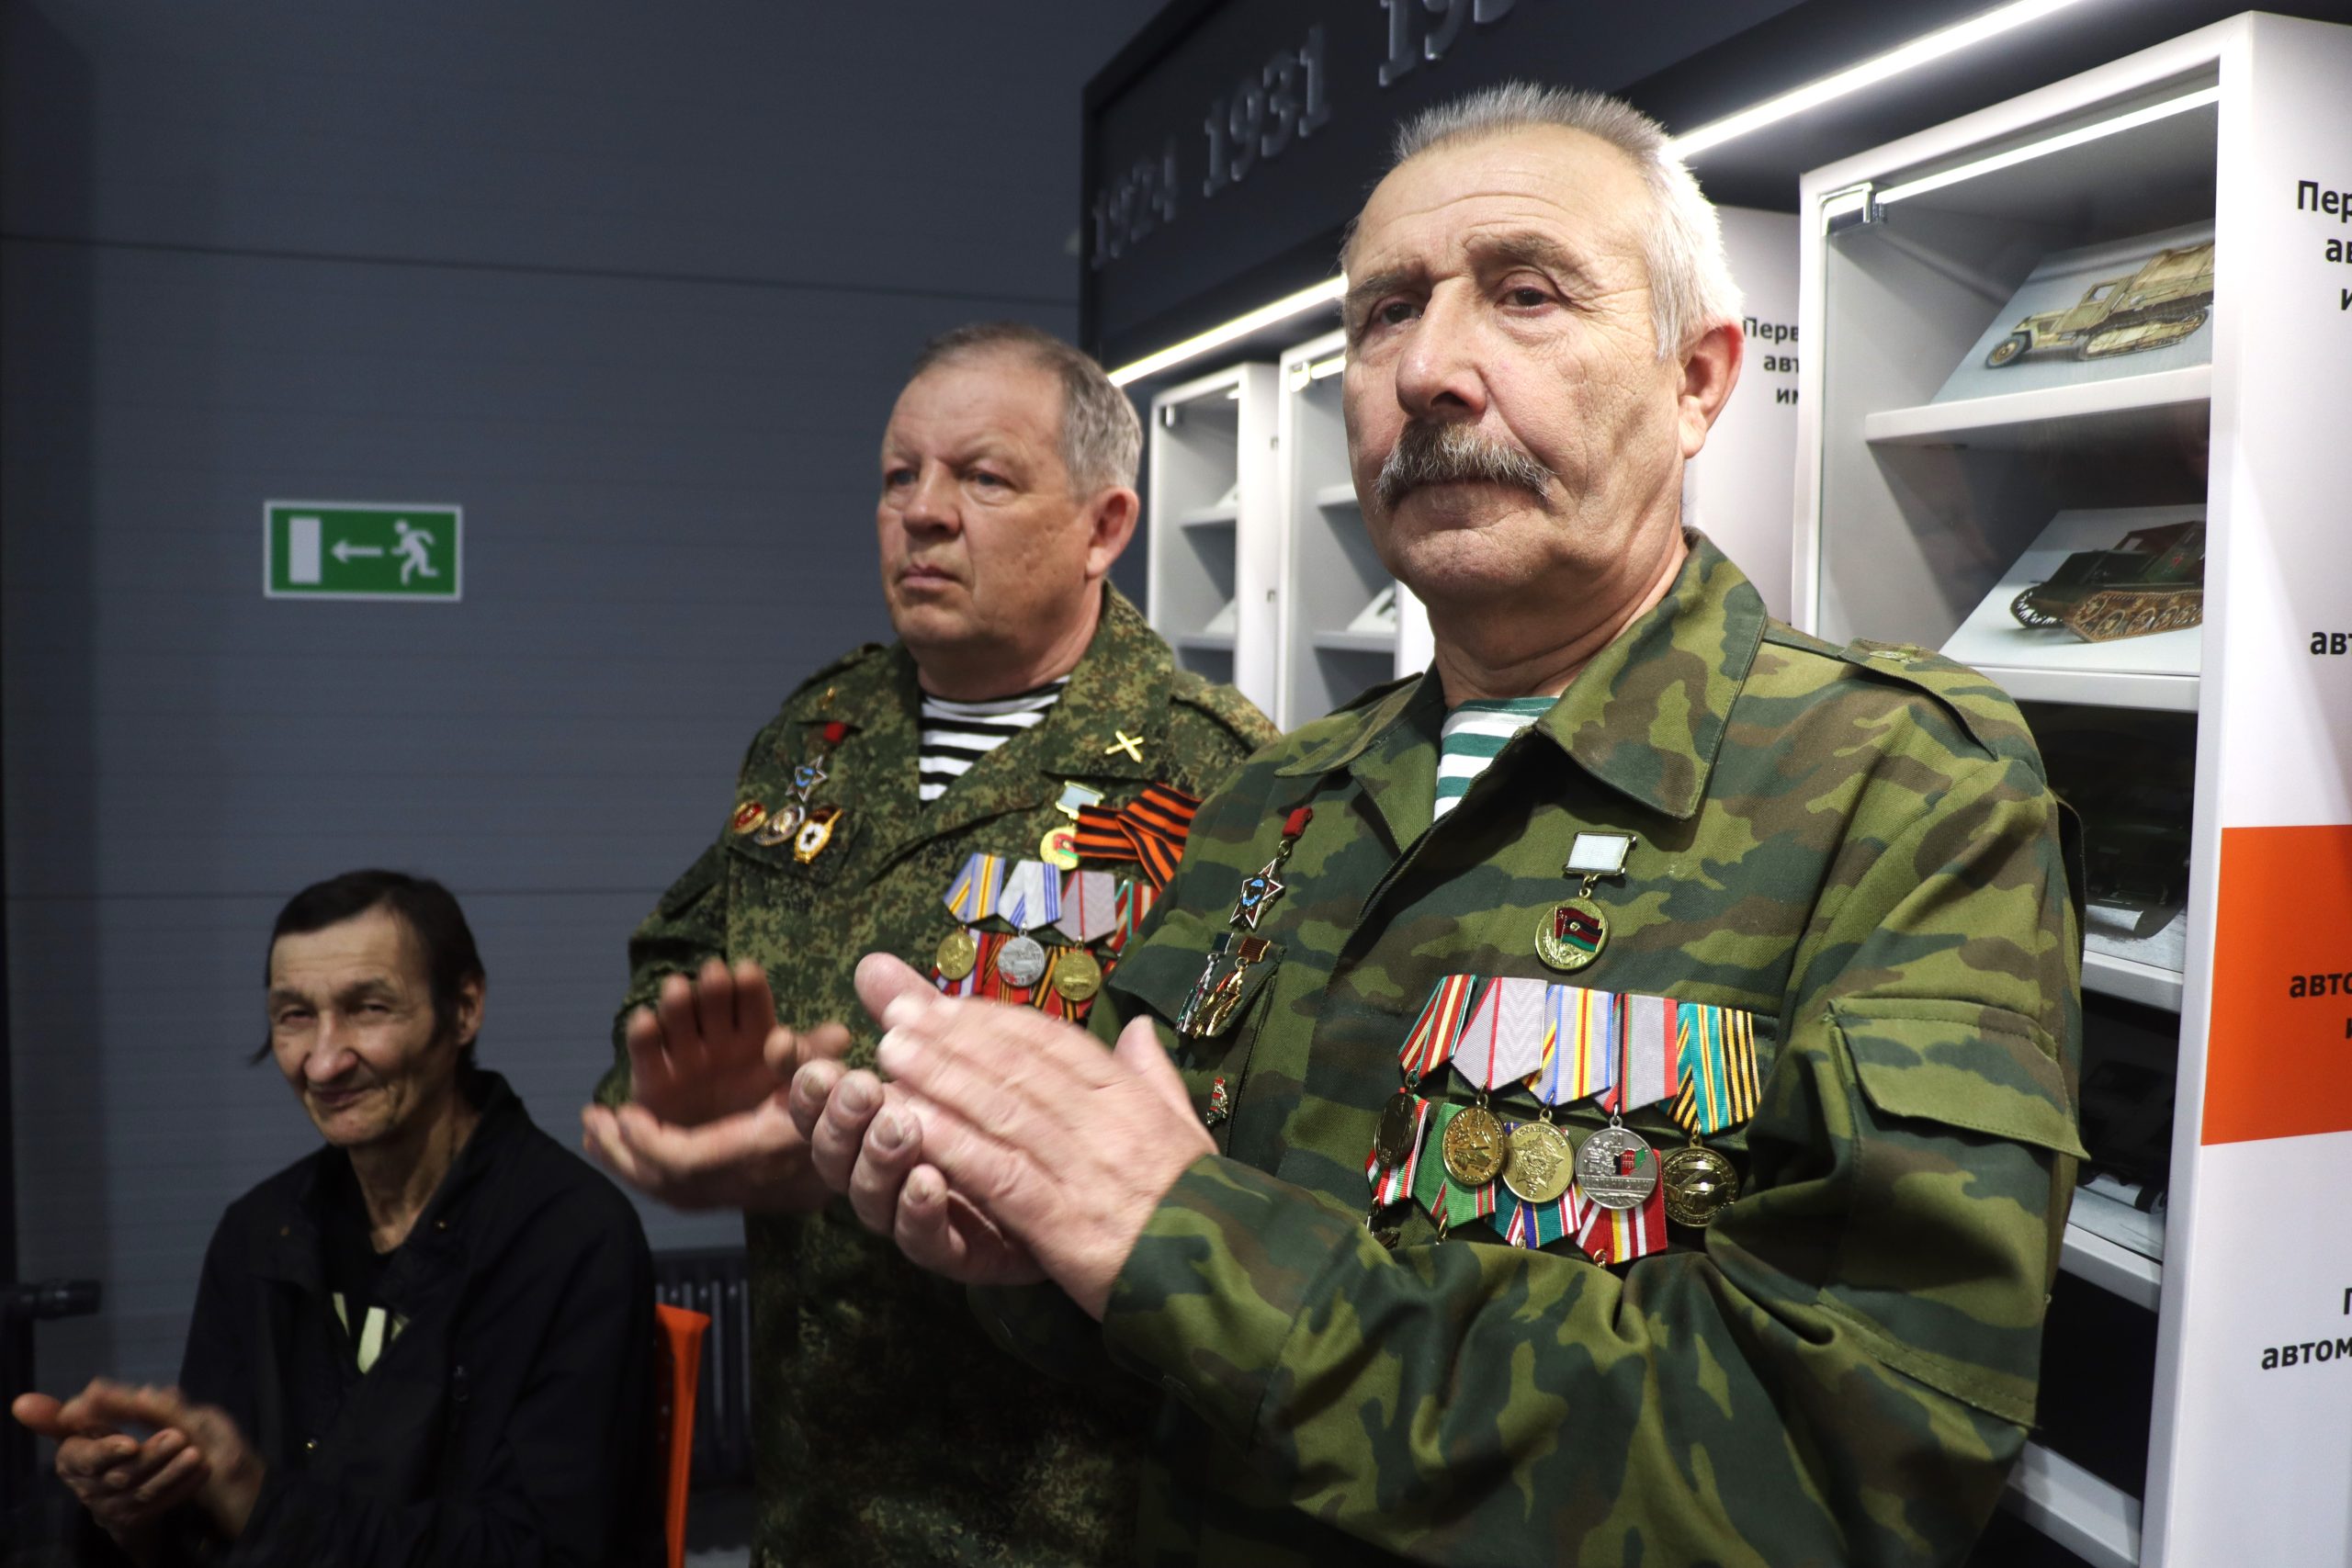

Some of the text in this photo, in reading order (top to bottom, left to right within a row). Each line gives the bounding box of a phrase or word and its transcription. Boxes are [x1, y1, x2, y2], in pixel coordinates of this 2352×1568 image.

[1204, 24, 1331, 197] 1931
[1379, 0, 1515, 86] 19
[1091, 135, 1180, 271] 1924
